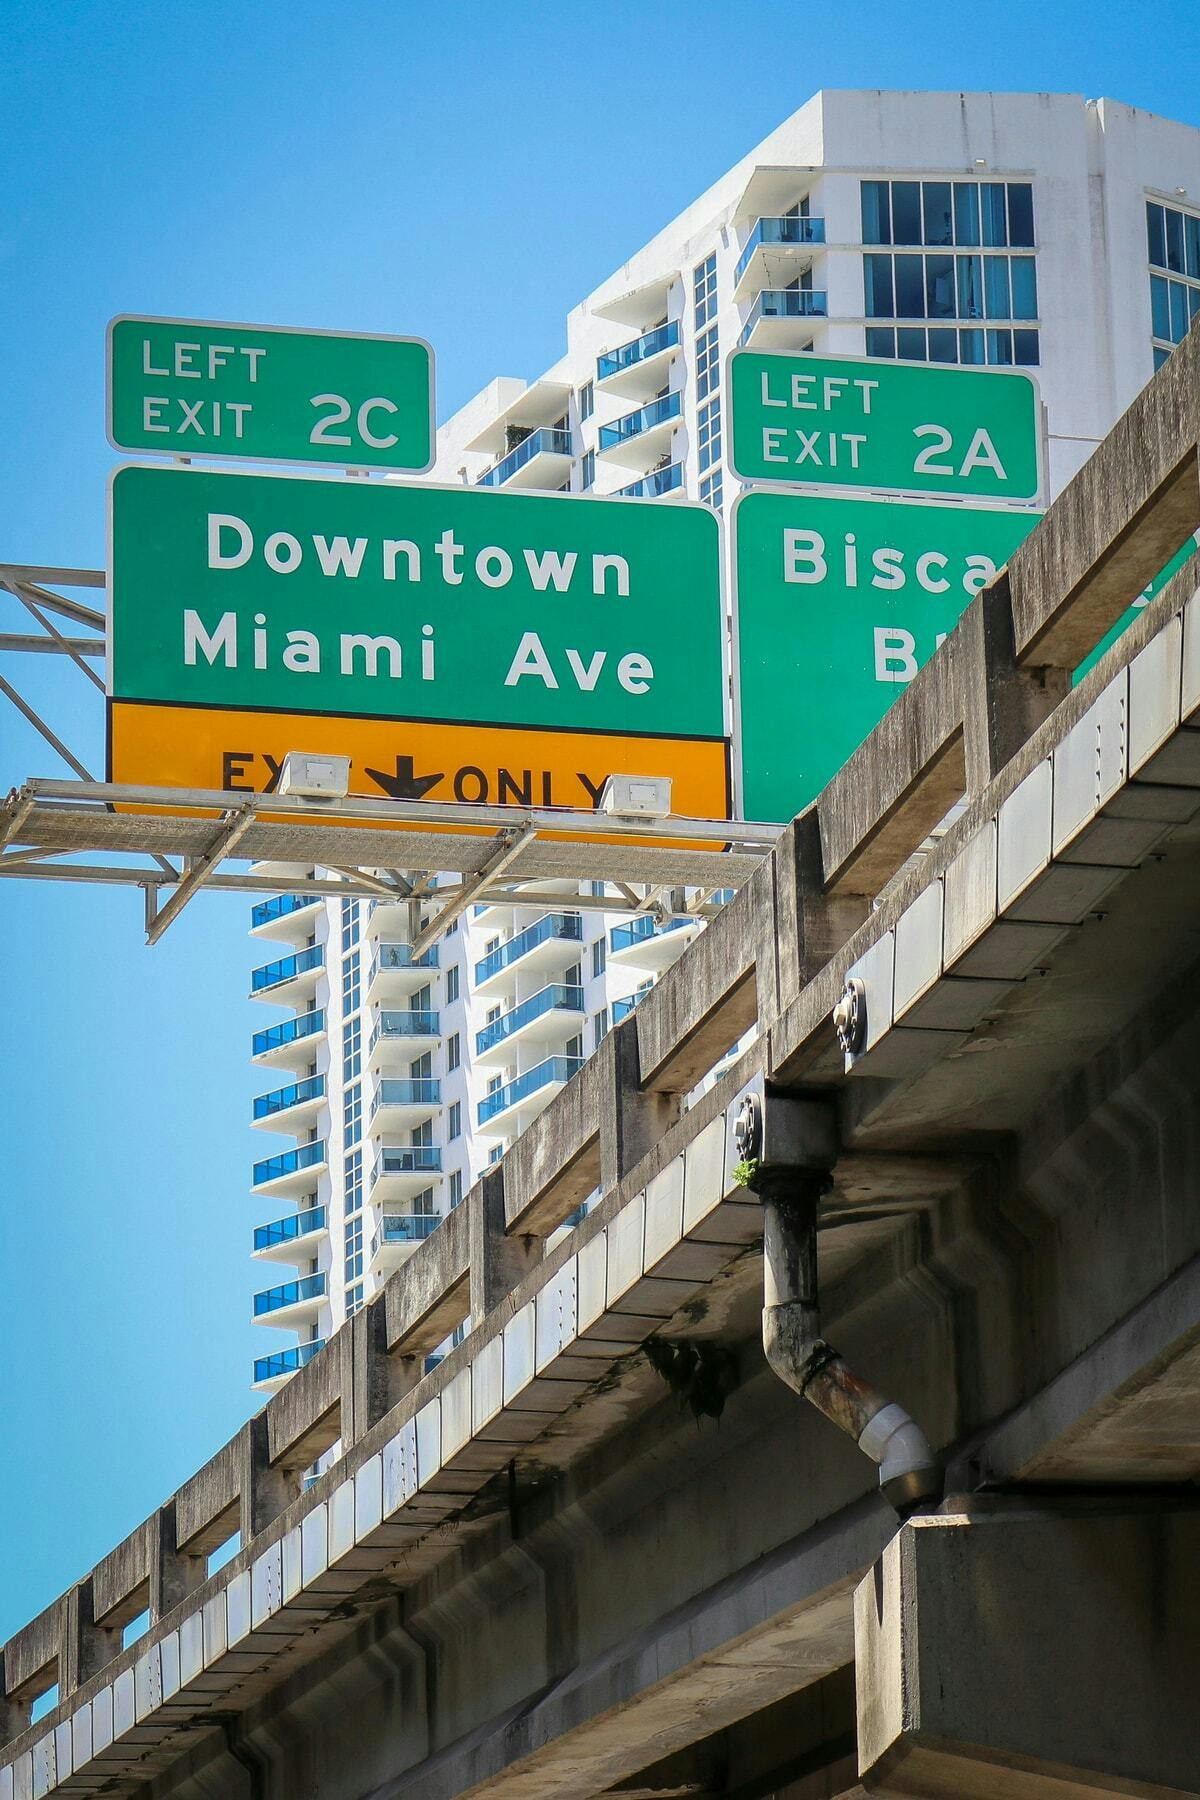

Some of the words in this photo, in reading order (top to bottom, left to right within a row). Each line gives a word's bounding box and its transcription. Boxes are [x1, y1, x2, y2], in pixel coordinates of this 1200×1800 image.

[143, 339, 267, 383] LEFT
[761, 371, 880, 414] LEFT
[143, 396, 253, 438] EXIT
[309, 393, 399, 449] 2C
[762, 427, 867, 469] EXIT
[912, 423, 1008, 480] 2A
[207, 512, 630, 597] Downtown
[183, 608, 436, 681] Miami
[503, 631, 655, 695] Ave
